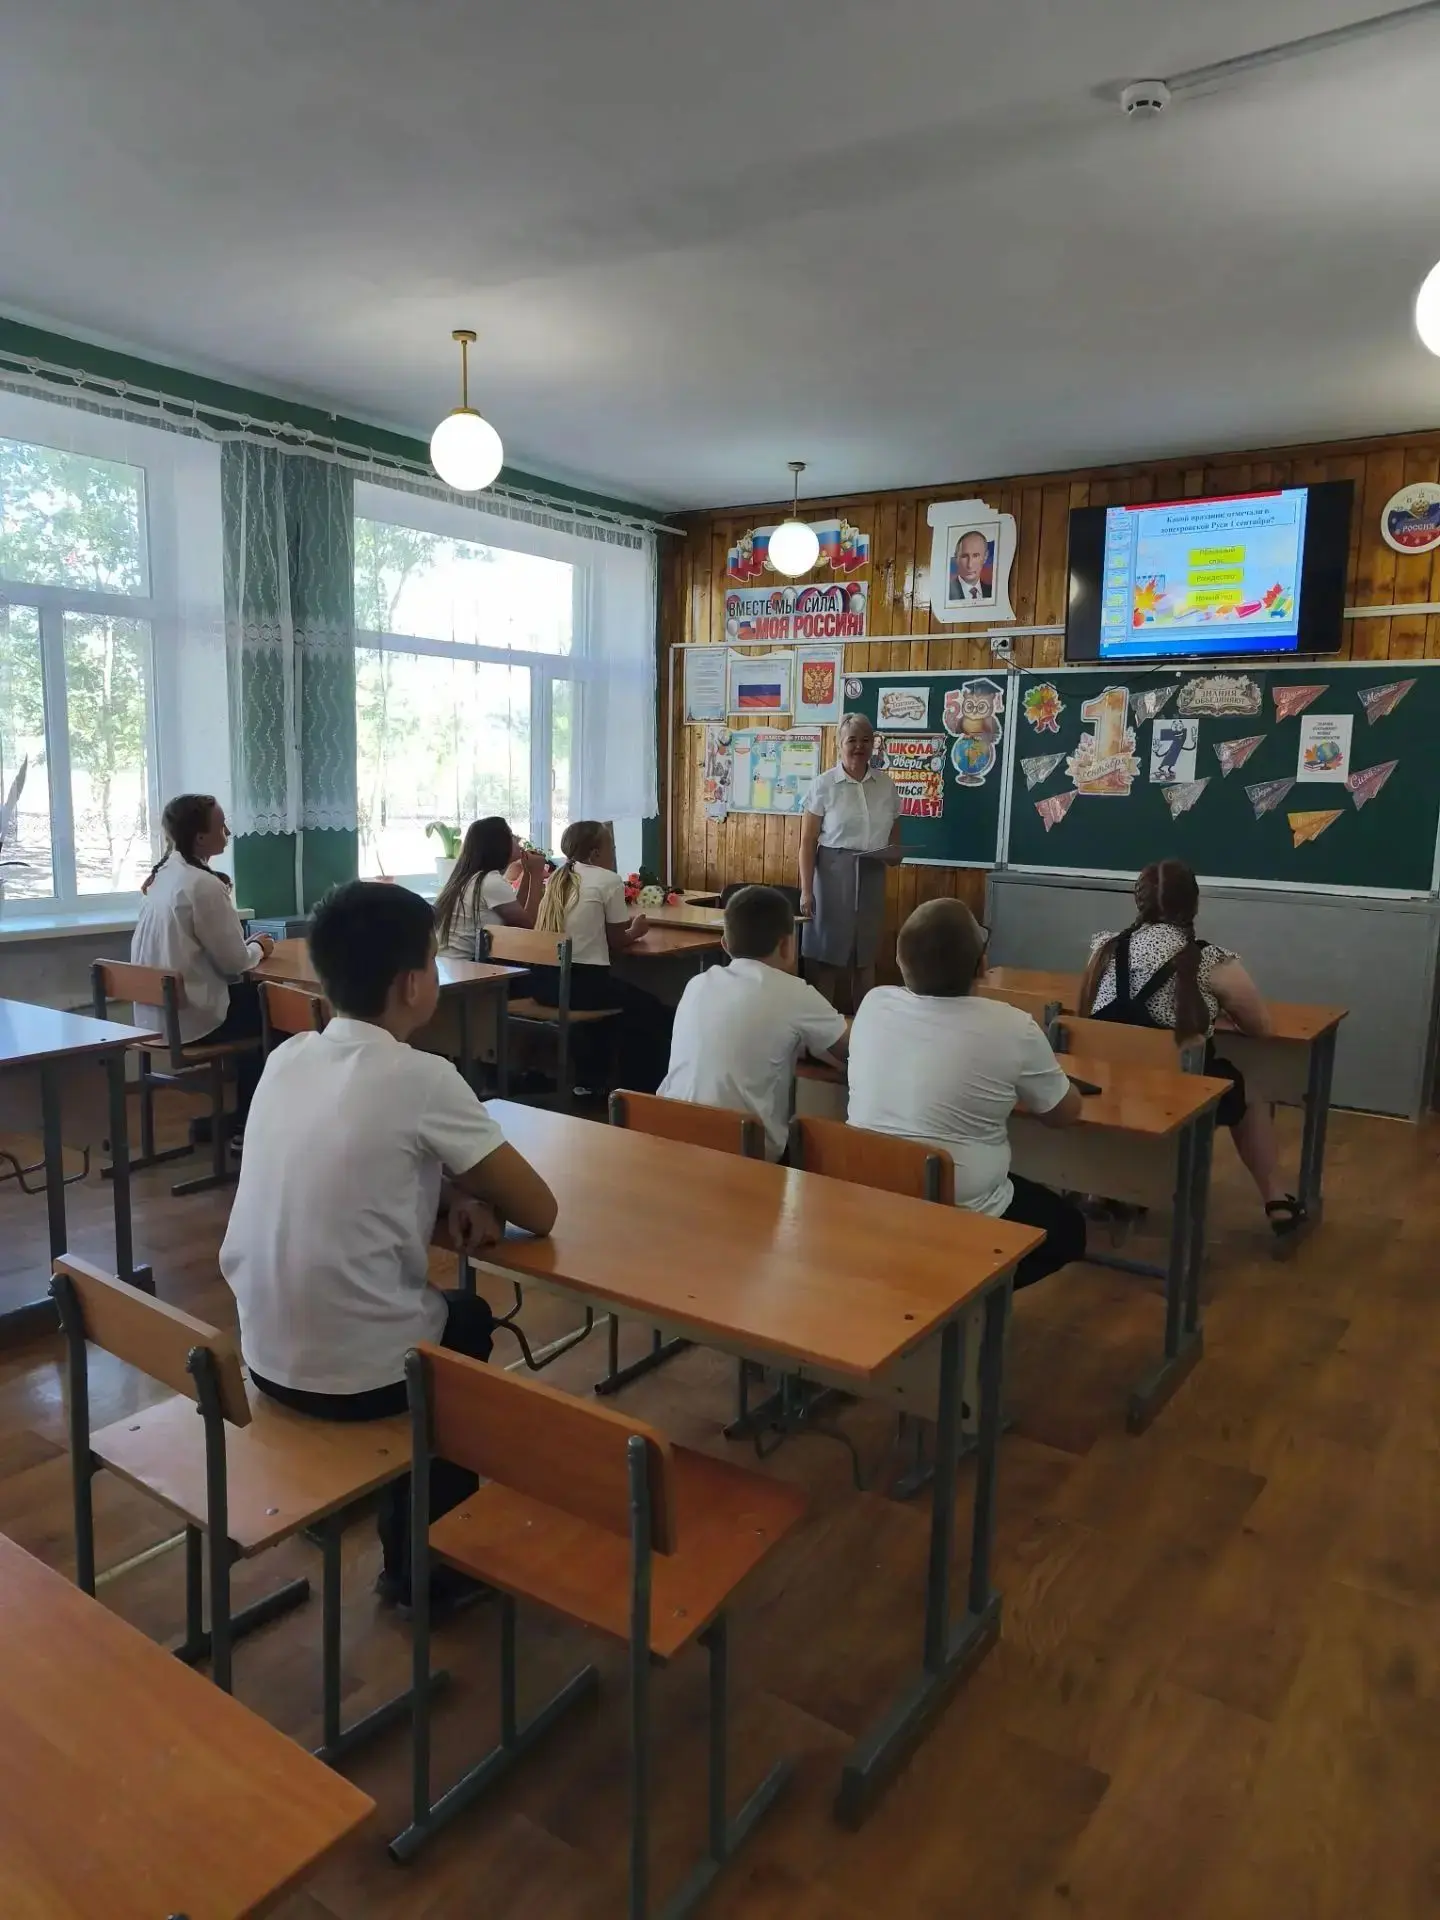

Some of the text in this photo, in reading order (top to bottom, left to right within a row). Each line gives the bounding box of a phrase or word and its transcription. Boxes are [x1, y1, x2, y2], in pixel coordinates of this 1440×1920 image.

[1211, 521, 1229, 530] Руси
[729, 599, 772, 617] ВМЕСТЕ
[775, 597, 796, 614] МЫ
[755, 613, 864, 640] МОЯ РОССИЯ!
[888, 743, 933, 755] ШКОЛА
[893, 754, 923, 771] двери
